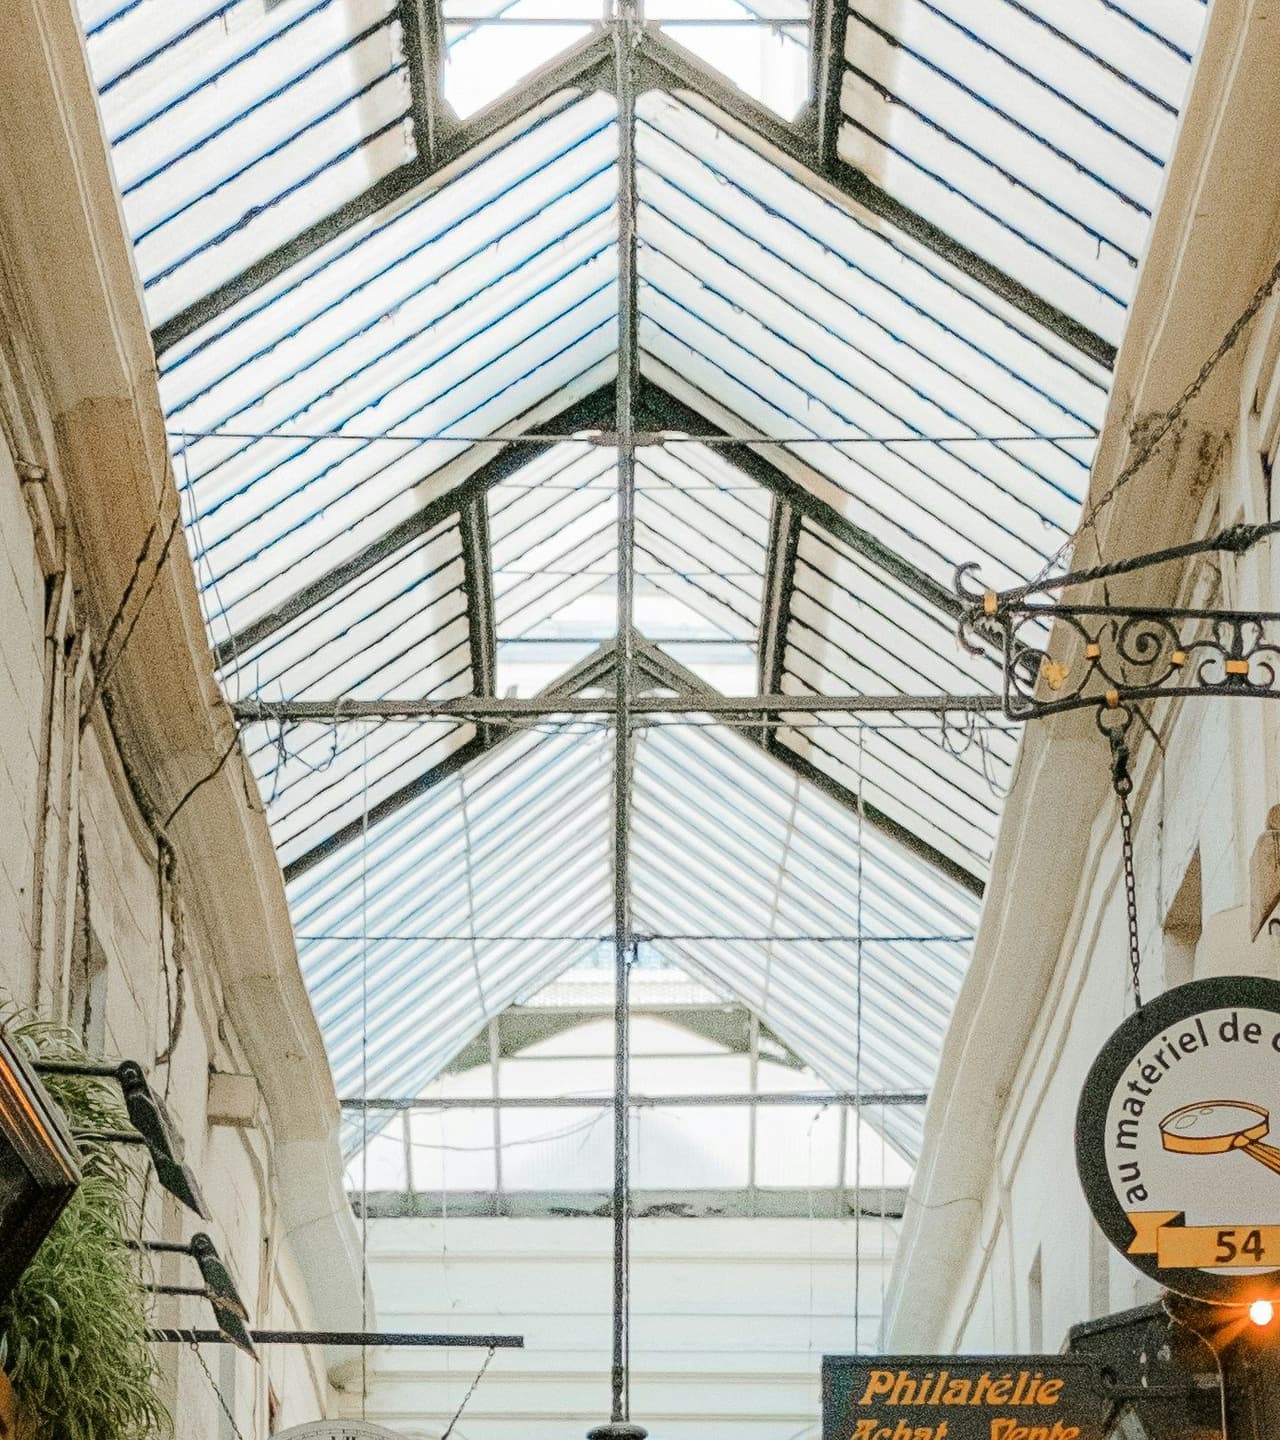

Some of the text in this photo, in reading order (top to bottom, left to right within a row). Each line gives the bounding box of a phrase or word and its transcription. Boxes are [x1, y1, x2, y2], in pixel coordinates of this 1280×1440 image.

[1218, 1011, 1263, 1045] de
[1115, 1017, 1209, 1151] matériel
[1116, 1161, 1149, 1205] au
[1214, 1228, 1266, 1263] 54
[858, 1369, 1065, 1407] Philatélie
